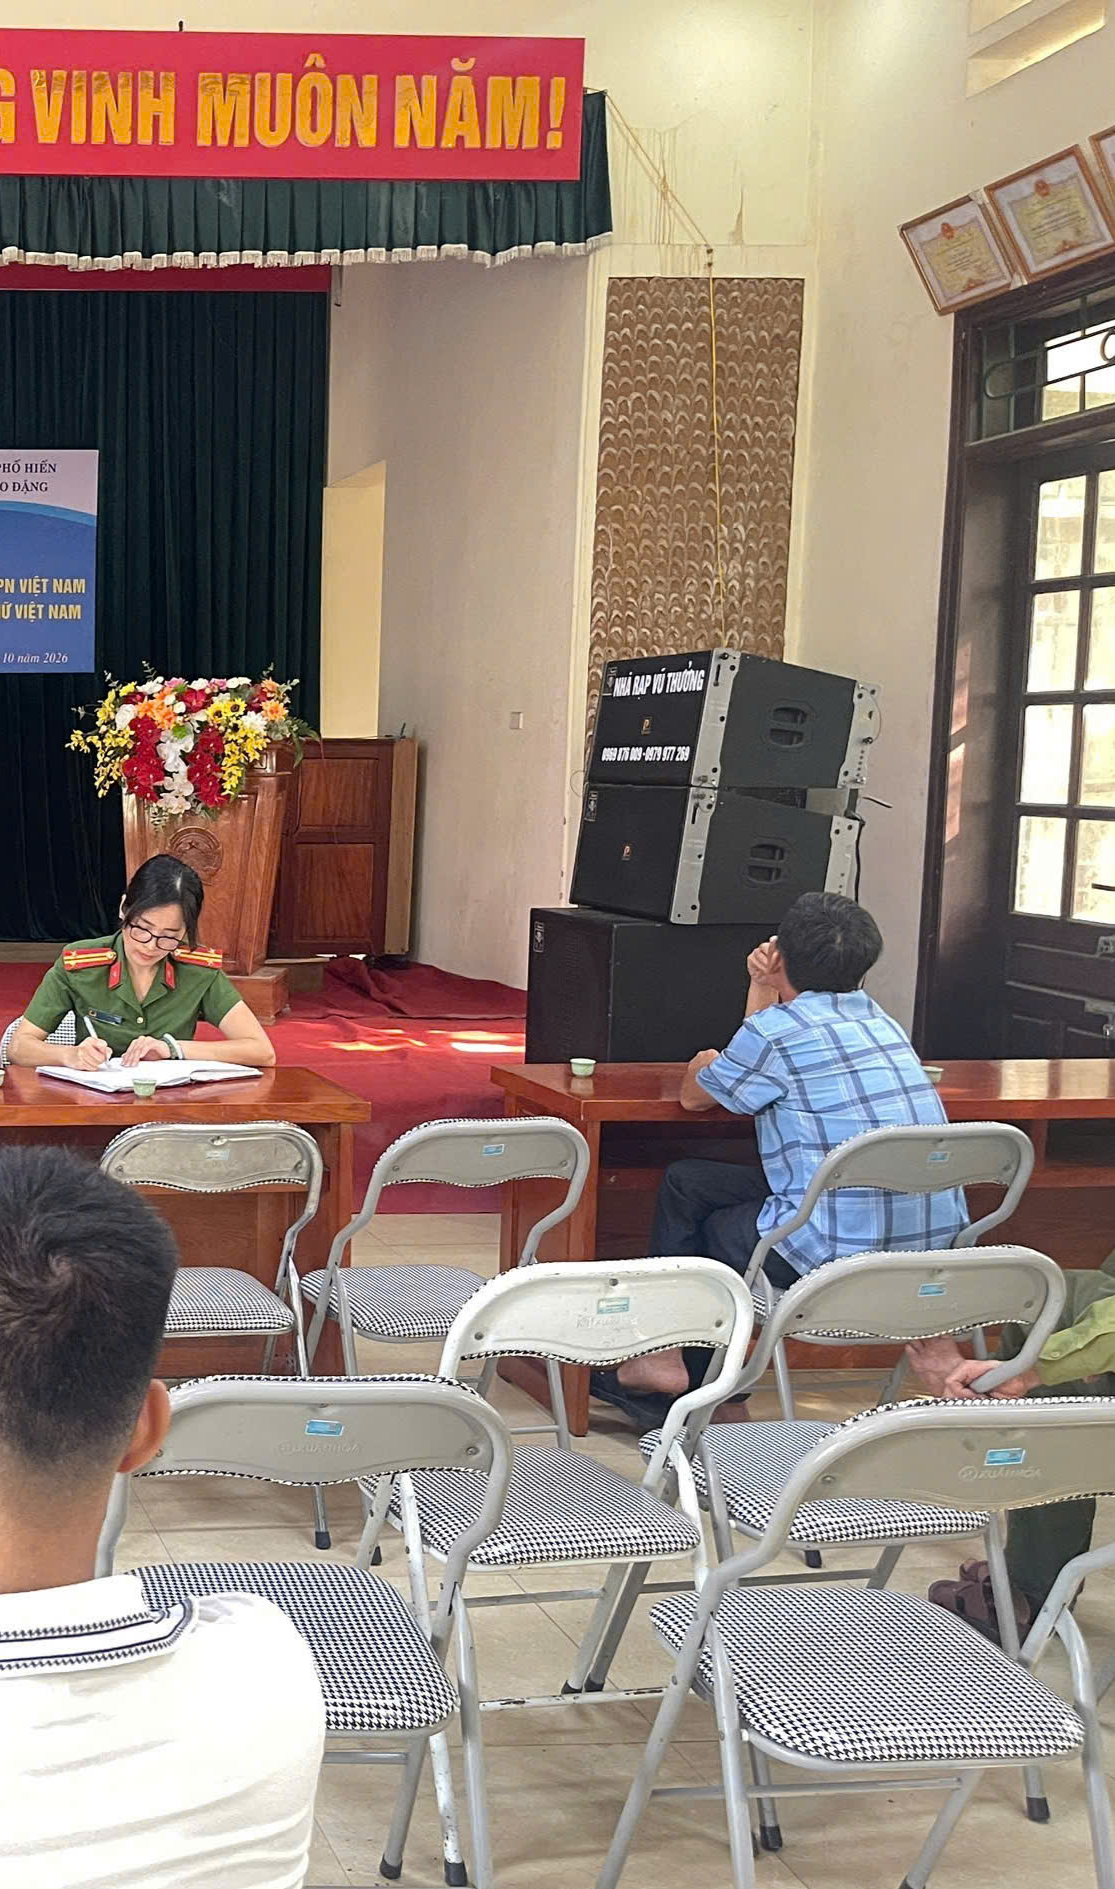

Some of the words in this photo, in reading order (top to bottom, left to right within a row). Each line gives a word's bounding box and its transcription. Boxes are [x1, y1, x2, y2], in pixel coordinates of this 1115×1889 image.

[29, 69, 176, 146] VINH
[197, 53, 377, 148] MUÔN
[393, 57, 566, 150] NĂM!
[24, 459, 57, 473] HIẾN
[12, 479, 48, 494] ĐẶNG
[19, 575, 48, 597] VIỆT
[52, 578, 86, 594] NAM
[15, 601, 45, 622] VIỆT
[48, 604, 82, 620] NAM
[2, 652, 15, 664] 10
[43, 652, 69, 664] 2026
